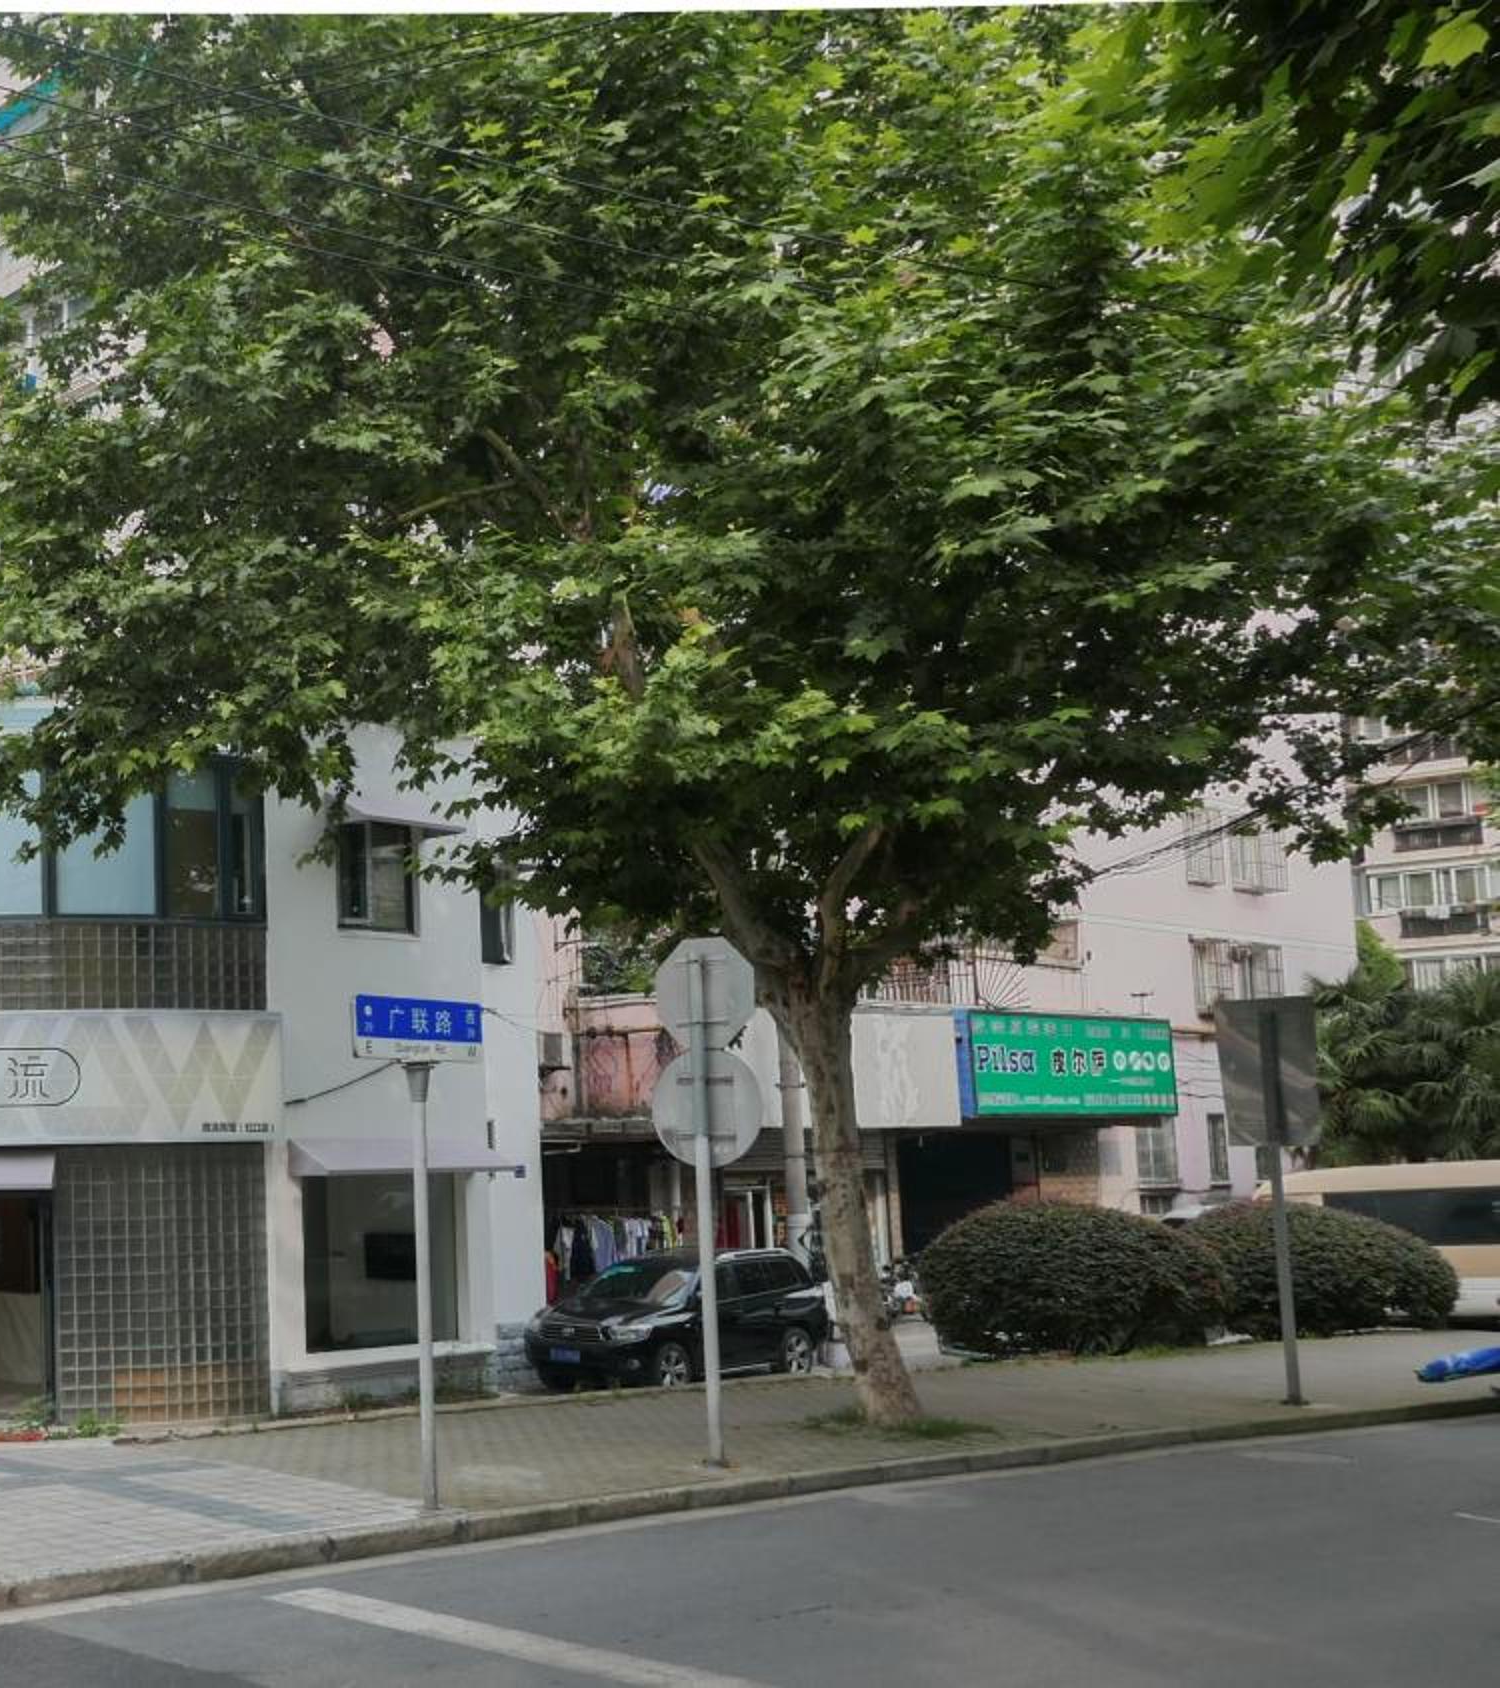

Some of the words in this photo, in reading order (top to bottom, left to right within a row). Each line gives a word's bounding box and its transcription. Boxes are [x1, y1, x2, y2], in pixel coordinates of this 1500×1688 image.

[388, 1006, 451, 1036] 广联路
[976, 1045, 1036, 1073] Pilsa
